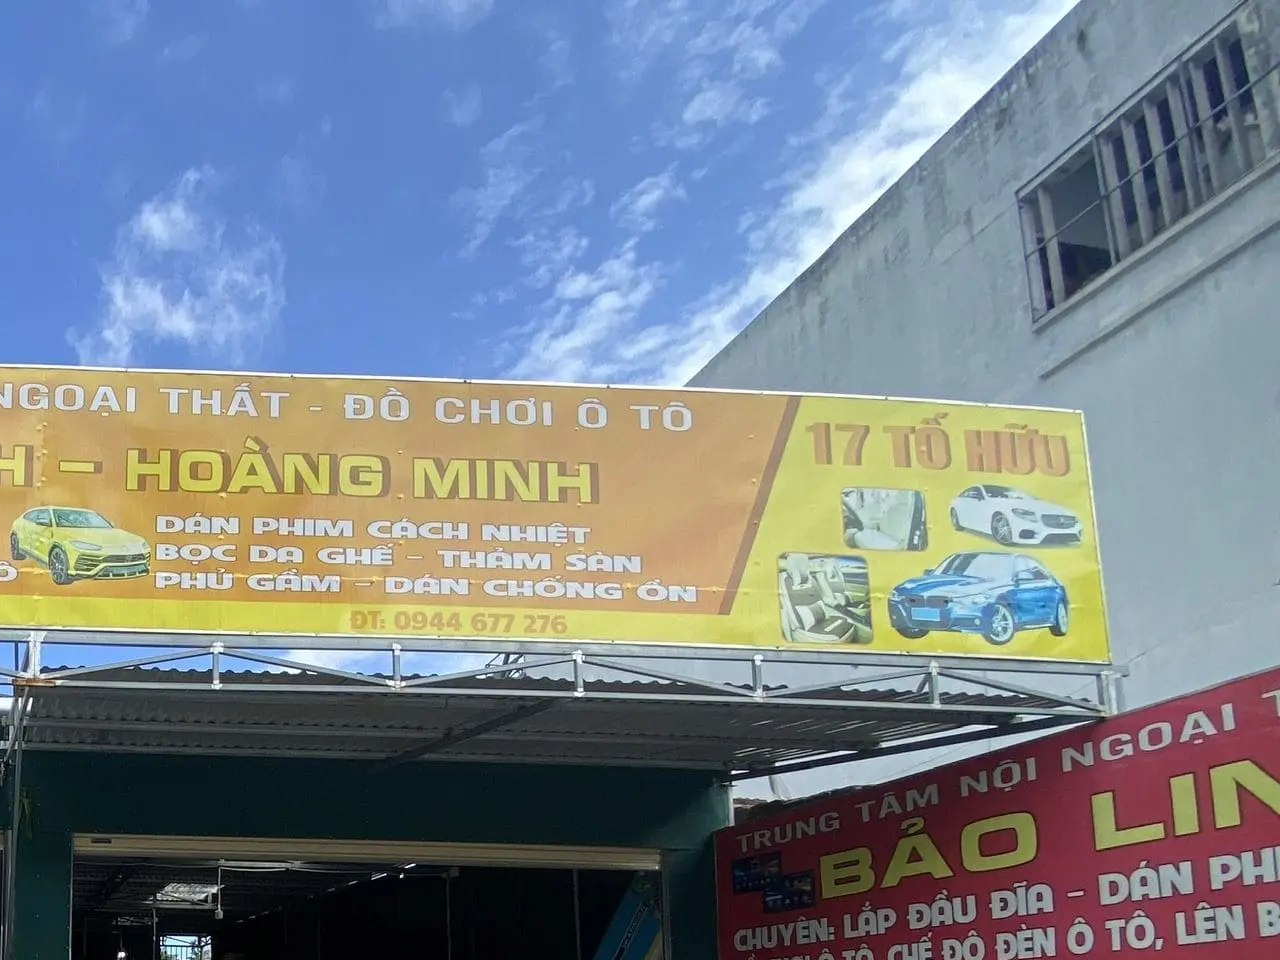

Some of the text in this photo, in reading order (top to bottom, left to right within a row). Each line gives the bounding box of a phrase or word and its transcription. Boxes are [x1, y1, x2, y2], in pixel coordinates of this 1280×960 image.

[159, 382, 290, 419] THẤT
[343, 387, 411, 422] ĐỒ
[434, 397, 554, 428] CHƠI
[577, 398, 608, 430] Ô
[629, 401, 693, 432] TÔ
[125, 435, 387, 498] HOÀNG
[412, 457, 596, 504] MINH
[805, 412, 1071, 477] 17 TỐ HỮU
[155, 513, 592, 547] DÁN PHIM CÁCH NHIỆT
[155, 543, 237, 565] BỌC
[249, 545, 304, 564] DA
[317, 542, 395, 566] GHẾ
[437, 546, 553, 570] THẢM
[565, 551, 642, 574] SÀN
[154, 567, 234, 590] PHỦ
[246, 568, 342, 593] GẦM
[384, 574, 469, 595] DÁN
[482, 575, 623, 600] CHỐNG
[636, 577, 698, 603] ỒN
[350, 610, 568, 635] ĐT: 0944 677 276
[735, 811, 840, 853] TRUNG
[854, 783, 939, 823] TÂM
[959, 757, 1037, 797] NỘI
[1061, 702, 1236, 773] NGOẠI
[819, 811, 1038, 900] BẢO
[733, 916, 835, 952] CHUYÊN:
[843, 901, 898, 939] LẮP
[906, 889, 977, 930] ĐẦU
[988, 880, 1055, 920] ĐĨA
[1098, 860, 1195, 906] DÁN
[994, 924, 1056, 960] ĐÈN
[1067, 917, 1095, 955] Ô
[1105, 909, 1164, 952] TÔ,
[1175, 901, 1246, 946] LÊN
